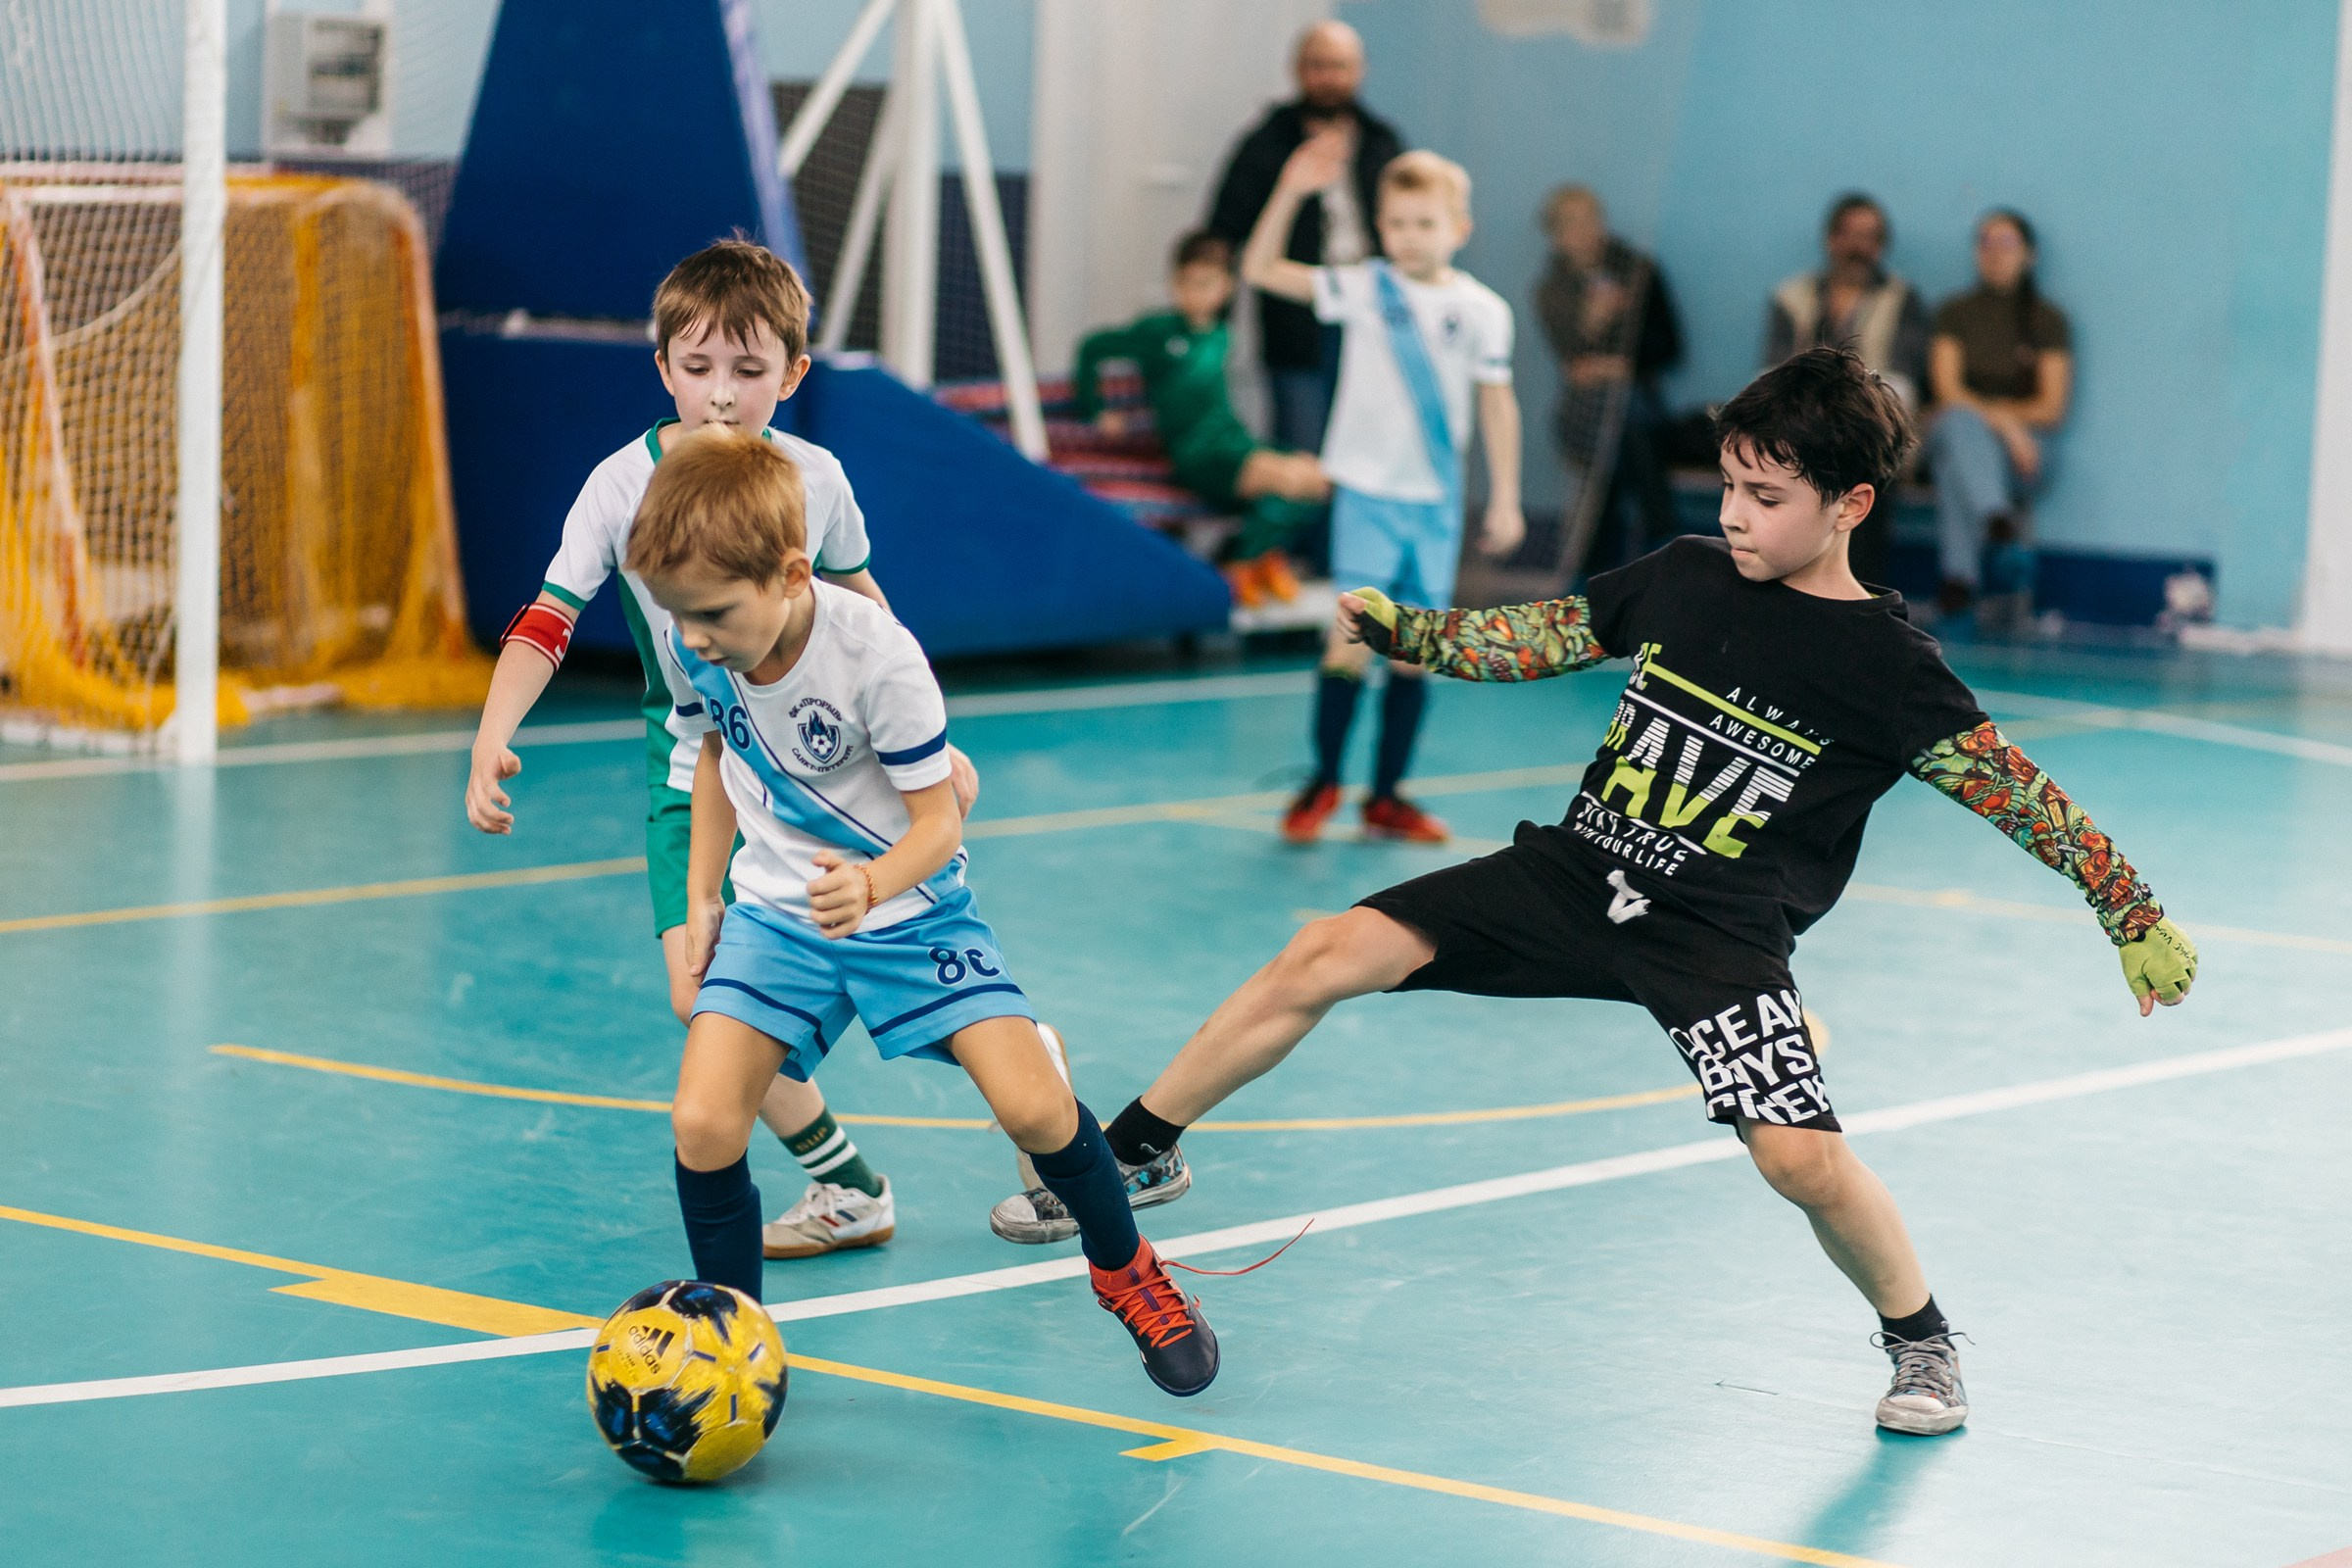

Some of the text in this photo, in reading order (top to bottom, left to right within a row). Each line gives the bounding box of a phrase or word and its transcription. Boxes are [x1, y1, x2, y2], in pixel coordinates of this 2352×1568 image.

[709, 697, 751, 750] 86
[1709, 714, 1817, 769] AWESOME
[1635, 849, 1679, 876] LIFE
[628, 1325, 662, 1374] adidas
